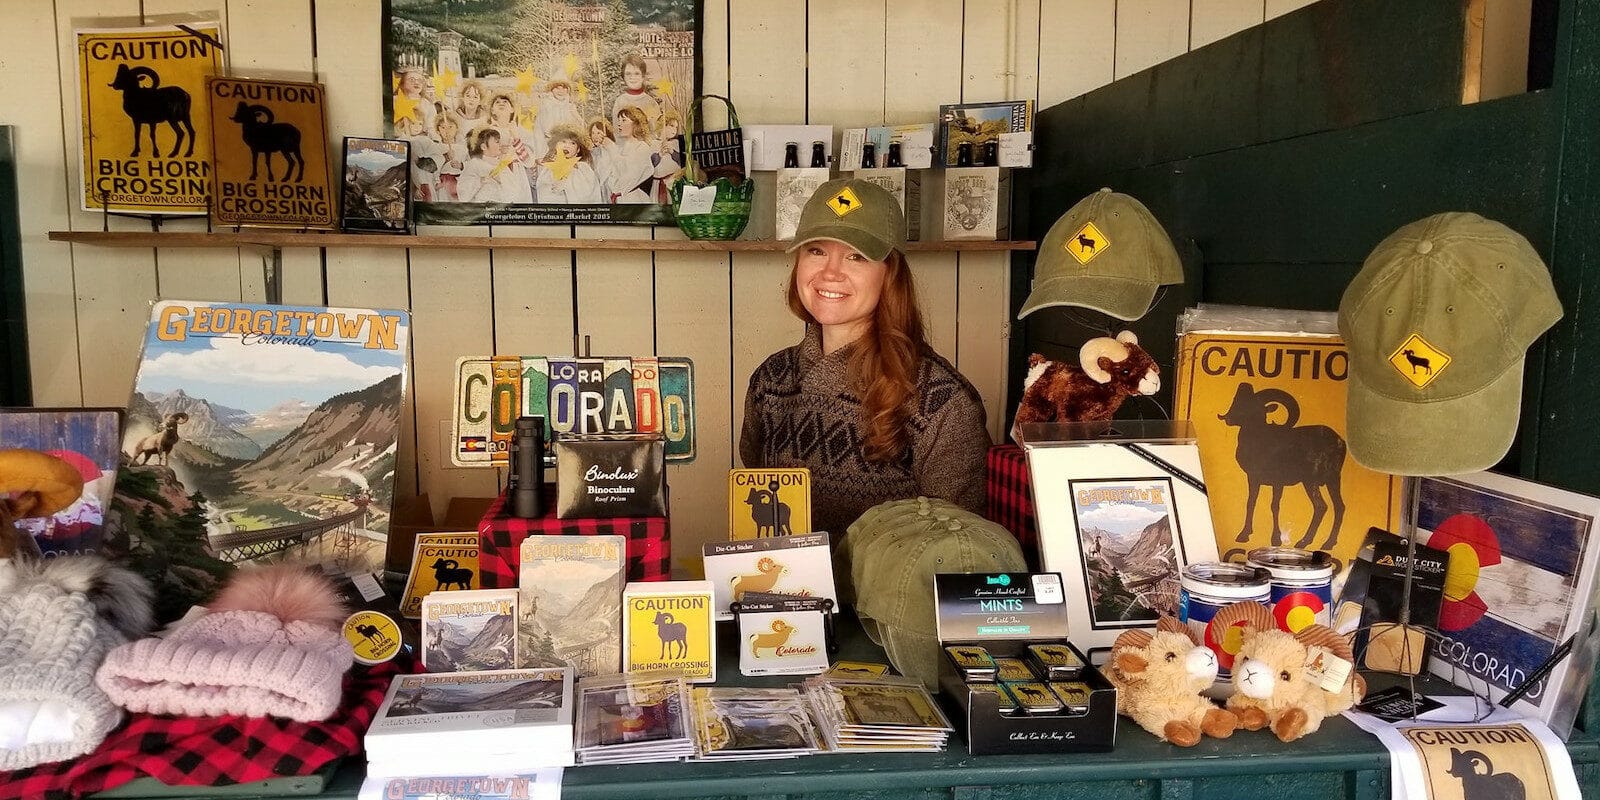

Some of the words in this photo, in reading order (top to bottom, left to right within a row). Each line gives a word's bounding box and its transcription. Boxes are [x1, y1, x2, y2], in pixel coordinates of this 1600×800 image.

[91, 38, 208, 61] CAUTION
[641, 47, 679, 57] ALPINE
[215, 82, 317, 104] CAUTION
[692, 131, 739, 150] ATCHING
[692, 147, 740, 168] ILDLIFE
[99, 159, 140, 176] BIG
[222, 182, 258, 198] BIG
[264, 184, 324, 201] HORN
[221, 198, 328, 216] CROSSING
[484, 212, 526, 221] Georgetown
[527, 212, 564, 221] Christmas
[565, 212, 591, 221] Market
[592, 212, 611, 221] 2005
[156, 305, 400, 350] GEORGETOWN
[240, 330, 319, 347] Colorado
[1200, 345, 1349, 381] CAUTIO
[464, 373, 687, 442] COLORADO
[583, 464, 639, 482] Binolux
[736, 473, 803, 487] CAUTION
[586, 485, 636, 494] Binoculars
[1078, 488, 1165, 506] GEORGETOWN
[424, 537, 478, 545] CAUTIO
[425, 548, 479, 558] CAUTIO
[521, 541, 618, 563] GEORGETOWN
[1395, 556, 1419, 565] DUT
[1420, 559, 1442, 569] CITY
[428, 600, 511, 620] GEORGETOWN
[635, 597, 704, 611] CAUTION
[980, 599, 1024, 612] MINTS
[346, 614, 372, 631] CAUTION
[776, 645, 817, 657] Colorado
[632, 663, 645, 671] BIG
[646, 662, 669, 671] HORN
[670, 660, 709, 669] CROSSING
[1440, 637, 1543, 699] COLORADO
[1416, 728, 1528, 745] CAUTION
[387, 776, 531, 800] GEORGETOWN
